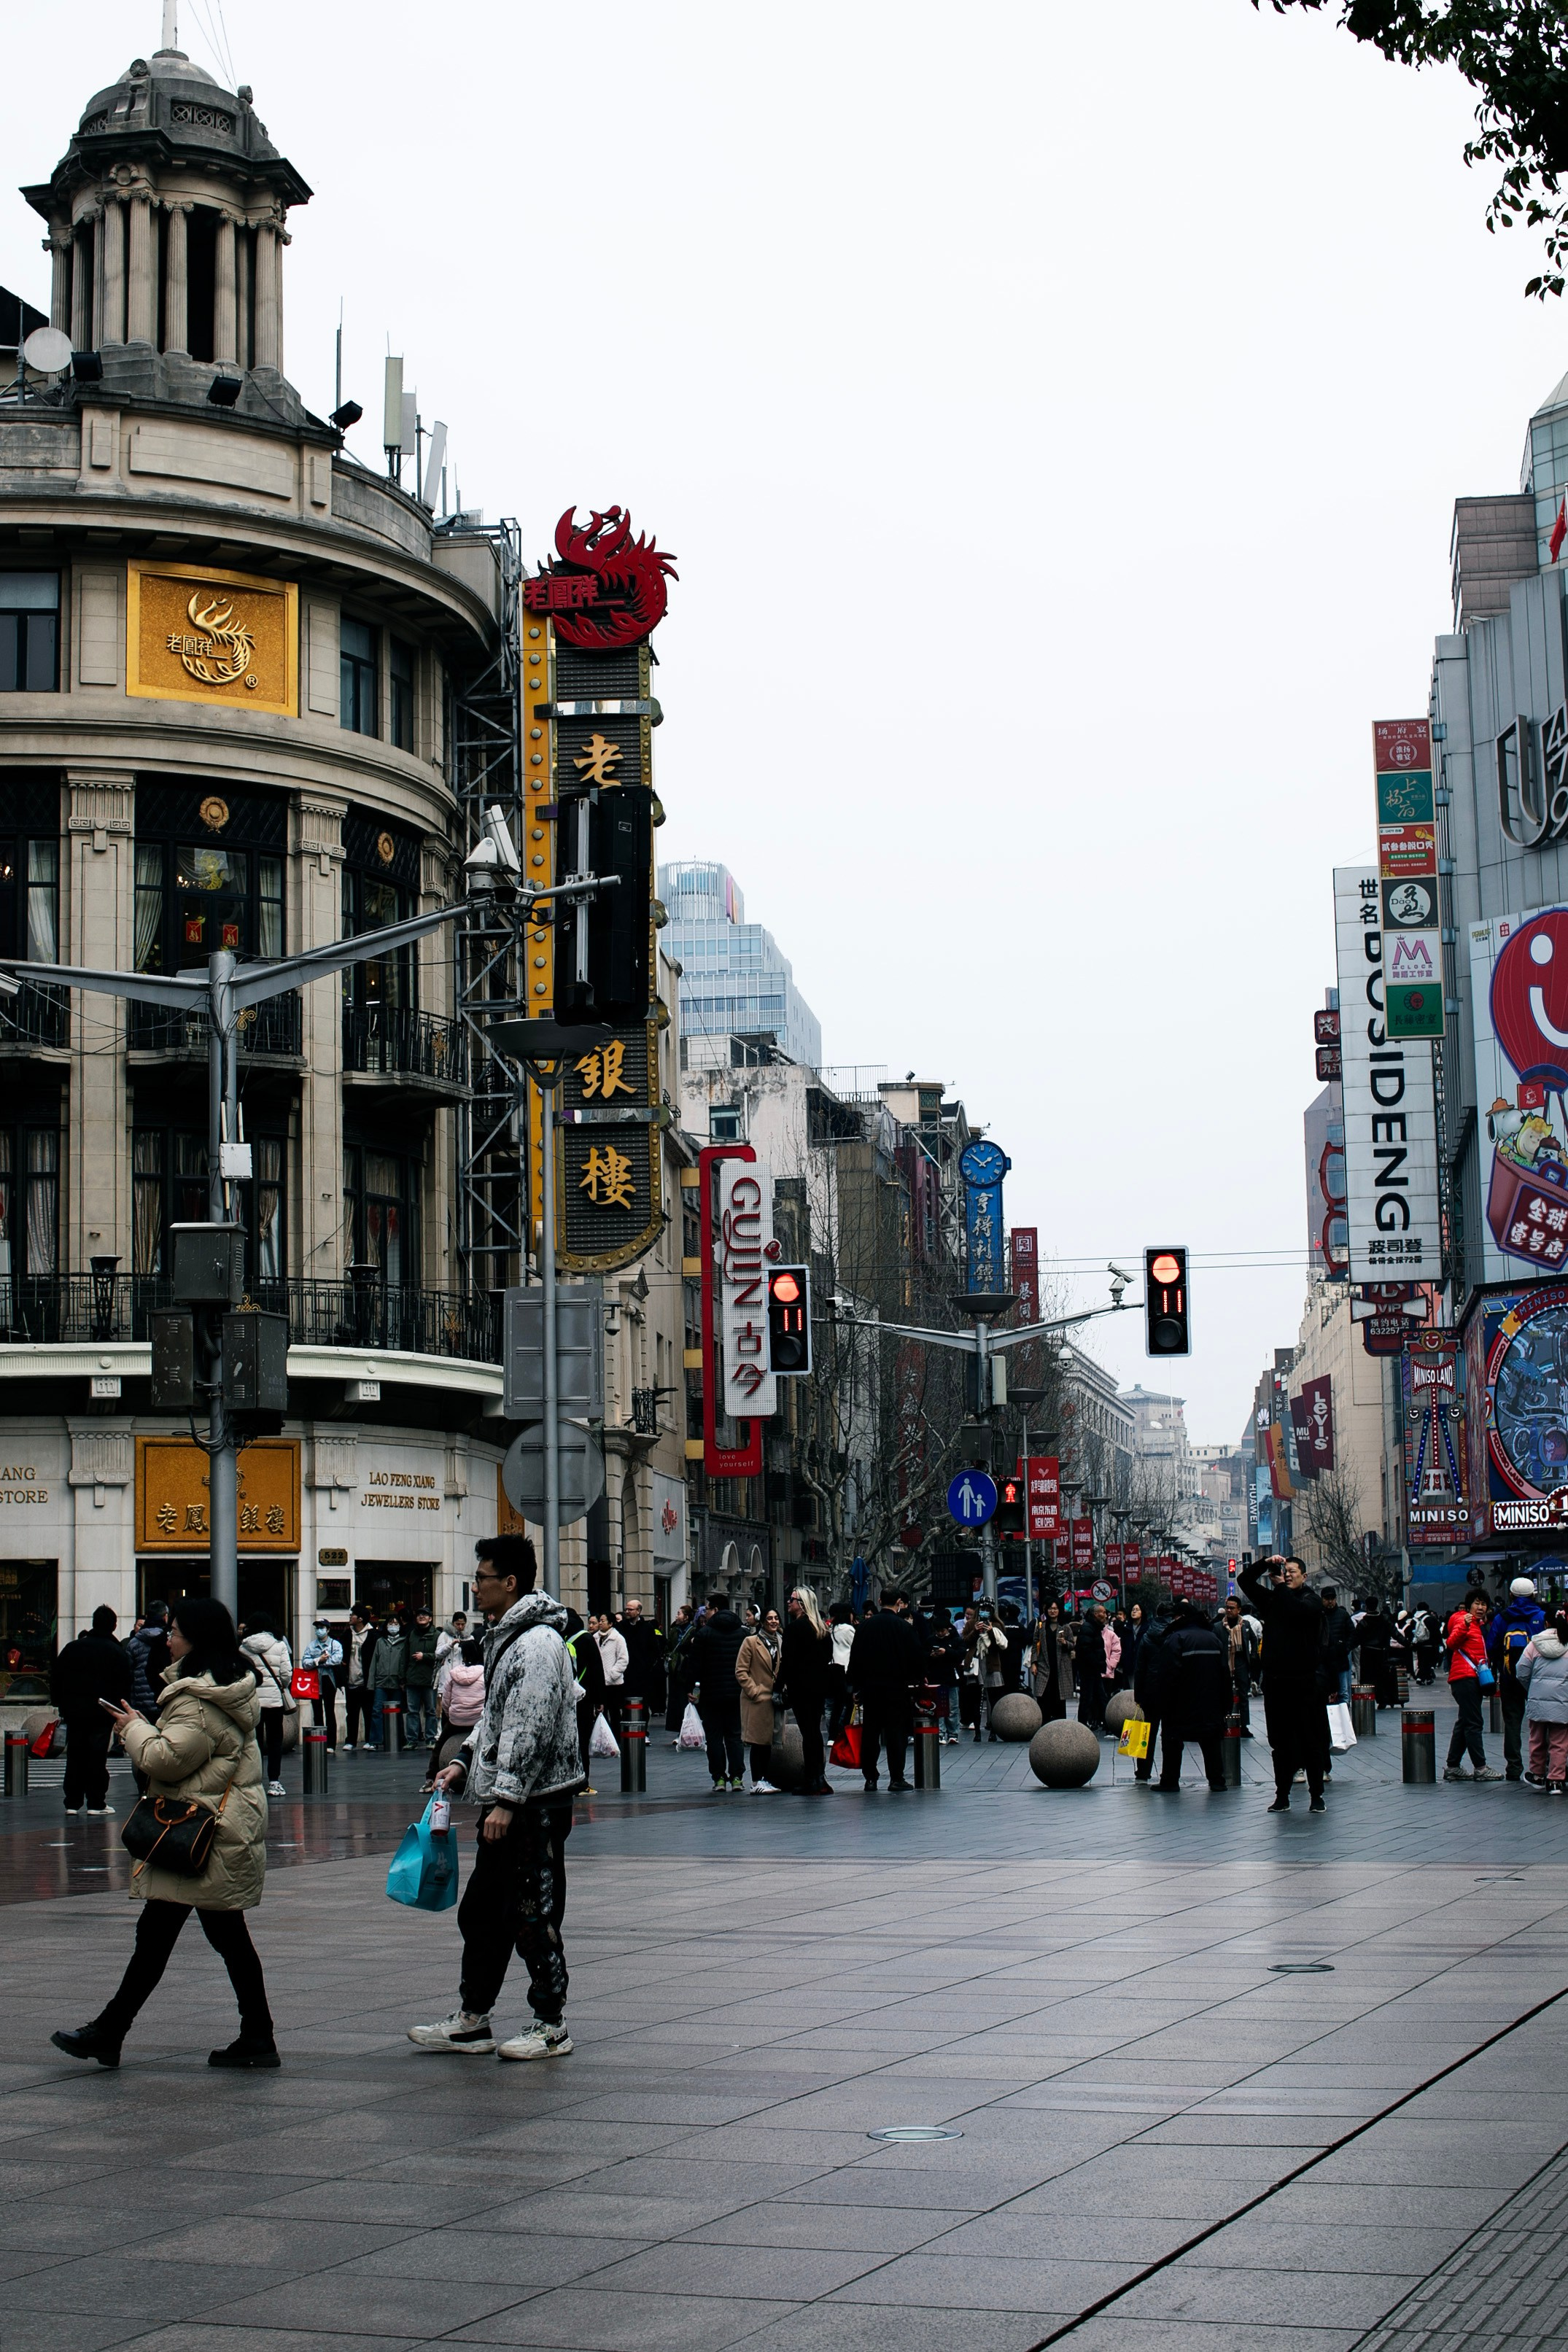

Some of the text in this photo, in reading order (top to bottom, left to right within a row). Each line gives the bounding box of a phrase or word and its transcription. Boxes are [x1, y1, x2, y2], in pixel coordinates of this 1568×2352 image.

[167, 633, 220, 659] 老鳳祥
[1319, 1014, 1340, 1036] 茂
[972, 1191, 994, 1294] 亨得利鐘
[1368, 1238, 1422, 1254] 波司登
[1377, 1303, 1402, 1313] VIP
[1519, 1291, 1565, 1316] MINISO
[1370, 1327, 1409, 1335] 632257
[1371, 1318, 1409, 1327] 预约电话
[732, 1321, 767, 1395] 古今
[1414, 1365, 1453, 1387] MINISO LAND
[1297, 1427, 1309, 1436] MU
[0, 1467, 36, 1480] ANG
[370, 1472, 435, 1489] LAO FENG XIANG
[1507, 1467, 1524, 1488] LAND
[361, 1494, 440, 1511] JEWELLERS STORE
[1031, 1505, 1057, 1515] 南京东路
[1249, 1483, 1257, 1525] HUAWEI
[156, 1502, 286, 1534] 老鳳銀樓
[1035, 1517, 1055, 1526] NEW OPEN
[1410, 1509, 1469, 1523] MINISO
[1498, 1505, 1549, 1524] MINISO
[324, 1551, 344, 1559] 522
